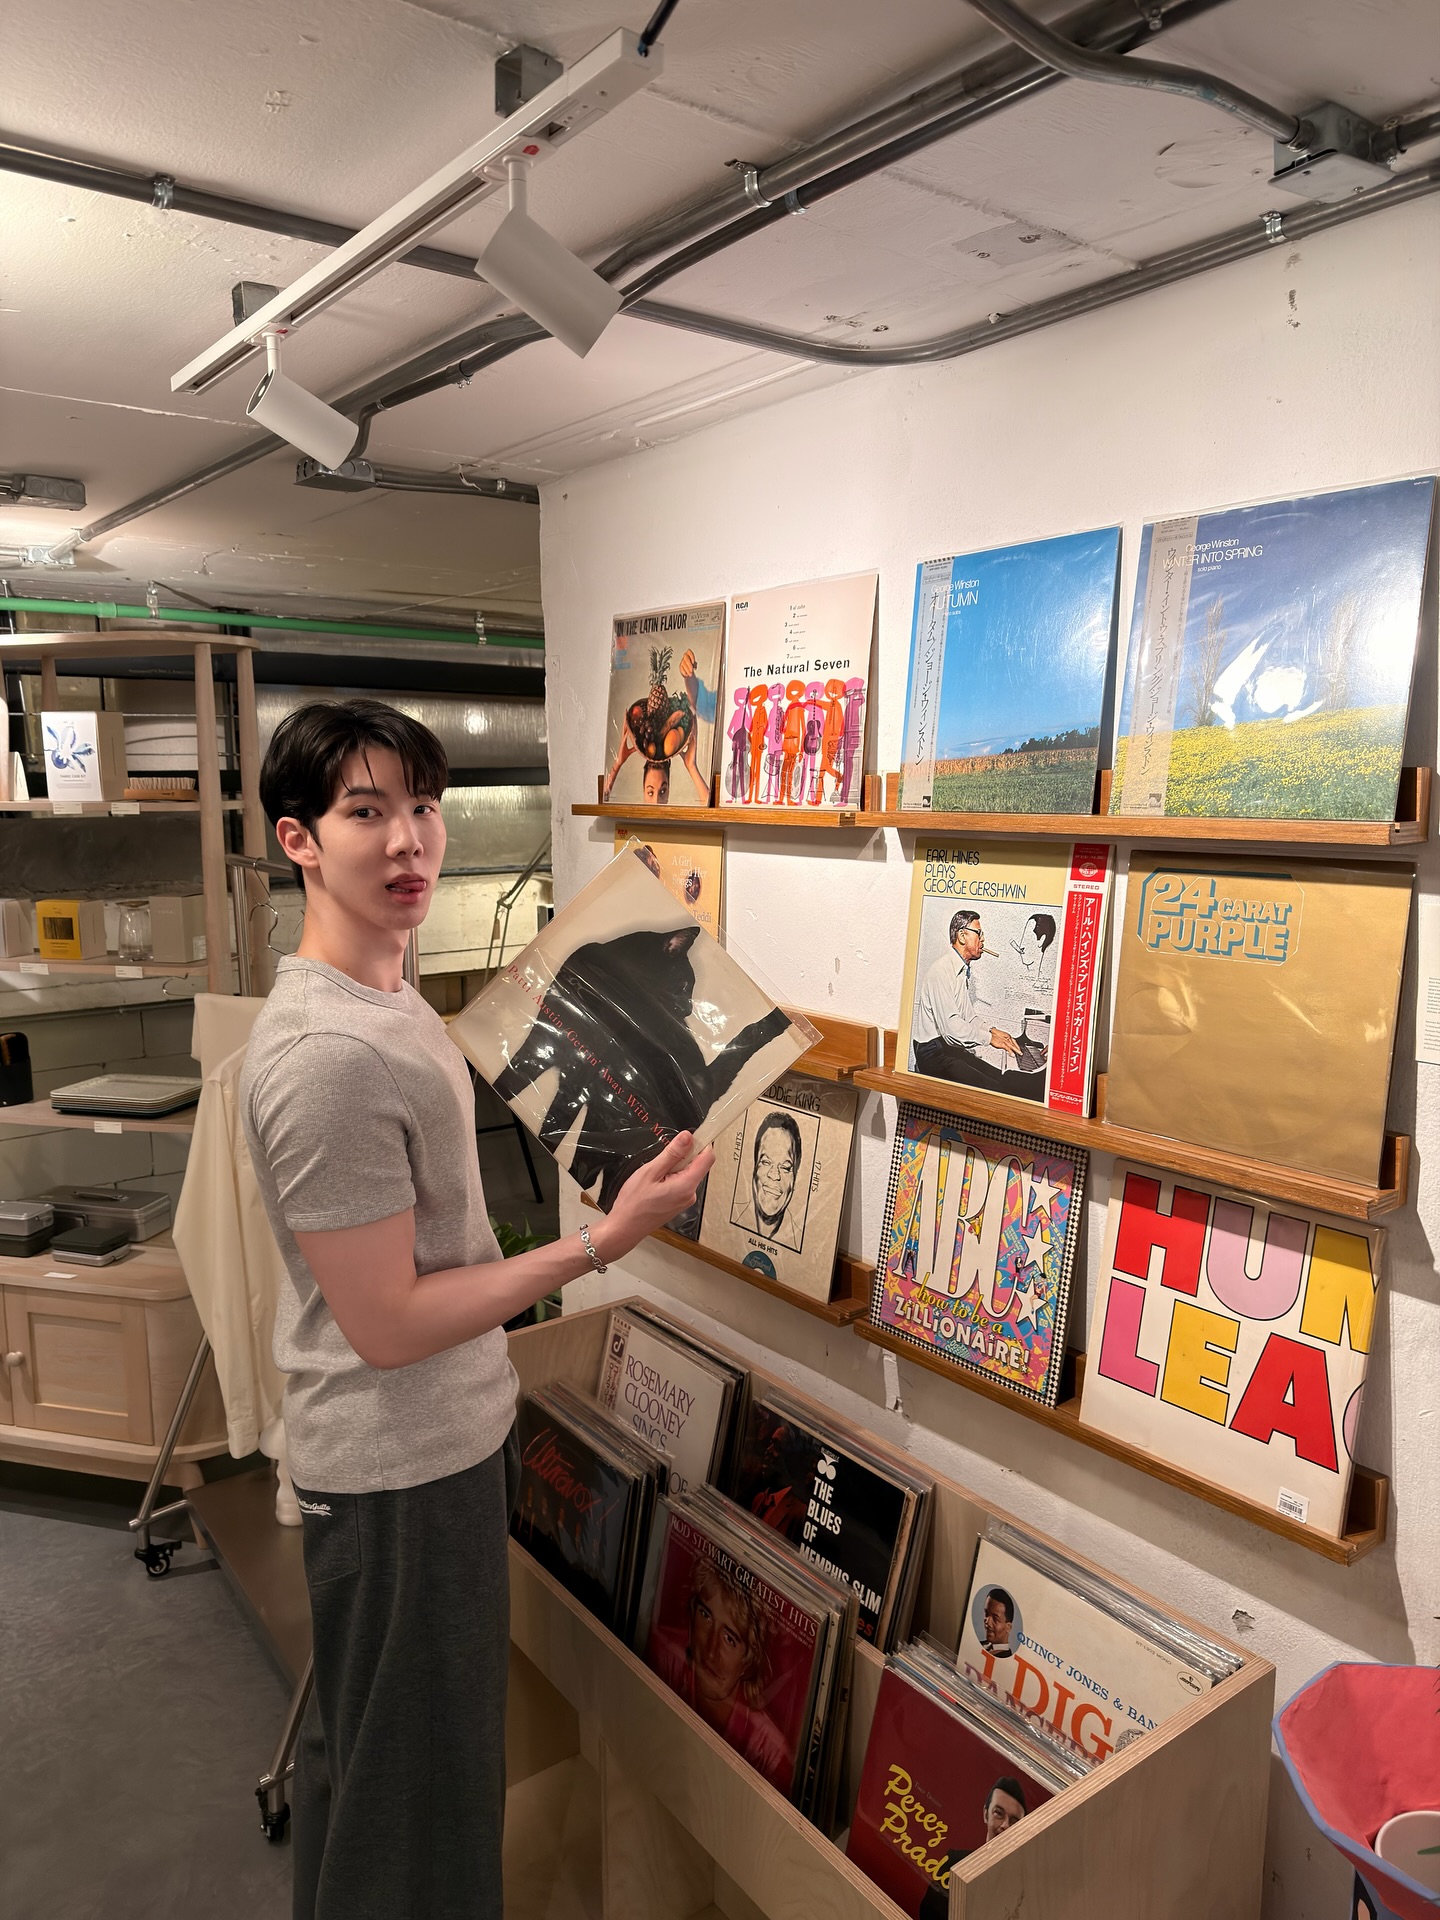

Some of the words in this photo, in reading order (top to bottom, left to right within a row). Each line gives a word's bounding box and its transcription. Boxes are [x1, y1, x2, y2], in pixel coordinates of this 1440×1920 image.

[1200, 550, 1224, 564] INTO
[1224, 545, 1263, 561] SPRING
[1211, 538, 1240, 550] Winston
[1197, 565, 1208, 573] solo
[1207, 564, 1221, 572] piano
[954, 579, 980, 591] Winston
[735, 601, 749, 610] RCA
[626, 620, 638, 636] THE
[640, 616, 659, 634] LATIN
[660, 613, 687, 632] FLAVOR
[744, 667, 762, 678] The
[767, 660, 809, 676] Natural
[814, 659, 850, 671] Seven
[671, 855, 678, 866] A
[678, 855, 693, 867] Girl
[925, 849, 948, 865] EARL
[949, 850, 980, 866] HINES
[672, 874, 693, 889] Songs
[680, 867, 693, 877] and
[694, 866, 708, 879] Her
[924, 863, 956, 881] PLAYS
[924, 878, 967, 897] GEORGE
[969, 881, 1027, 899] GERSHWIN
[1073, 883, 1100, 891] STEREO
[1150, 874, 1217, 920] 24
[1217, 897, 1293, 925] CARAT
[692, 909, 712, 923] Teddi
[1147, 914, 1293, 963] PURPLE
[508, 965, 534, 993] Patti
[599, 1067, 625, 1095] Away
[627, 1093, 649, 1123] With
[794, 1089, 821, 1112] KING
[735, 1131, 743, 1150] HITS
[811, 1172, 820, 1193] HITS
[892, 1133, 1036, 1319] ABC
[748, 1237, 757, 1247] ALL
[757, 1242, 767, 1251] HIS
[766, 1246, 778, 1256] HITS
[916, 1271, 950, 1310] how
[952, 1298, 969, 1319] to
[971, 1293, 989, 1328] be
[625, 1353, 696, 1417] ROSEMARY
[1097, 1276, 1367, 1474] LEA
[624, 1382, 687, 1439] CLOONEY
[813, 1476, 834, 1505] THE
[807, 1498, 842, 1535] BLUES
[803, 1520, 818, 1543] OF
[670, 1514, 691, 1540] ROD
[692, 1531, 735, 1573] STEWART
[735, 1563, 788, 1614] GREATEST
[789, 1606, 817, 1638] HITS
[800, 1542, 850, 1584] MEMPHIS
[852, 1579, 882, 1615] SLIM
[1016, 1631, 1064, 1669] QUINCY
[1066, 1665, 1110, 1701] JONES
[1113, 1697, 1124, 1711] &
[1127, 1705, 1159, 1731] BAN
[1012, 1653, 1114, 1761] DIG
[884, 1763, 948, 1848] Perez
[879, 1802, 950, 1890] Prado
